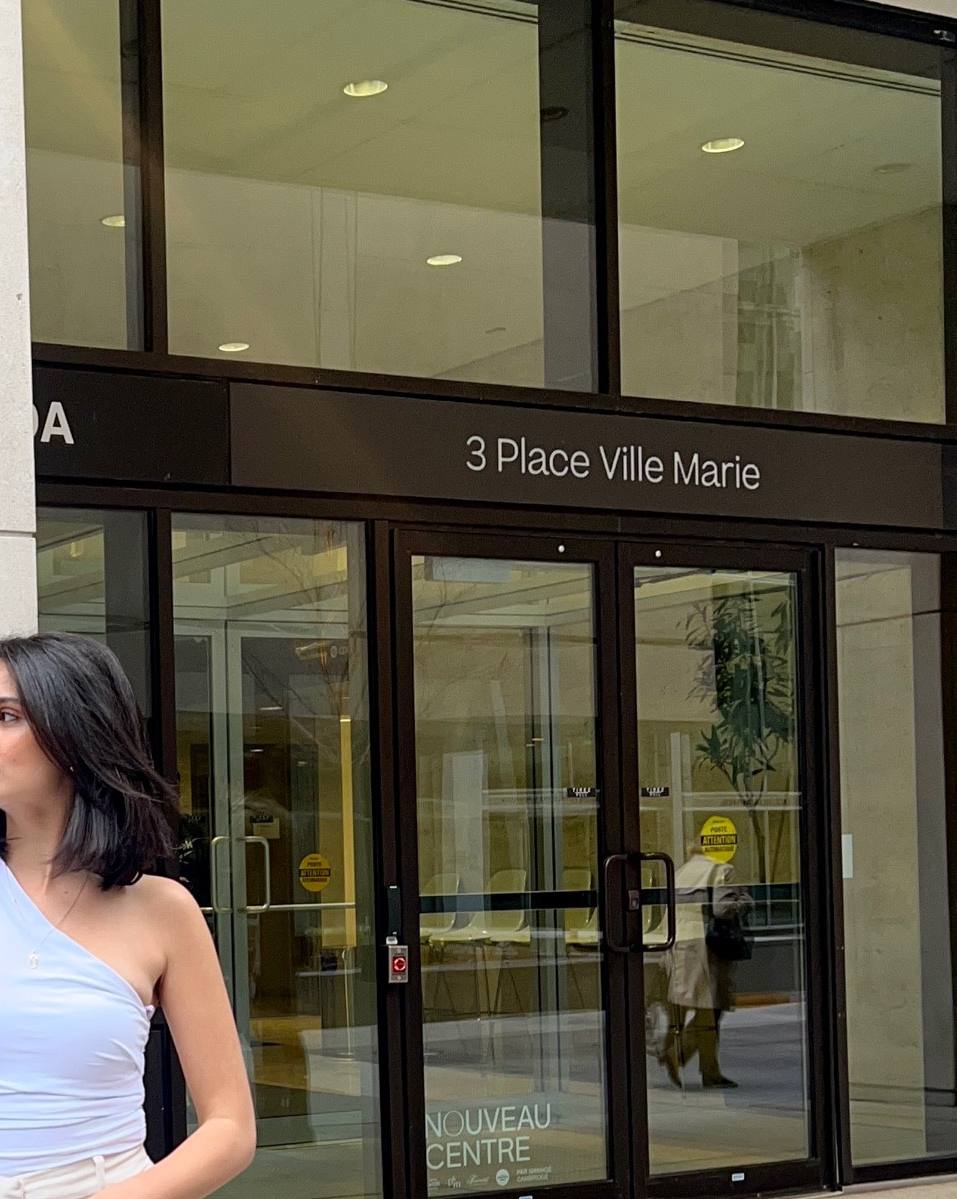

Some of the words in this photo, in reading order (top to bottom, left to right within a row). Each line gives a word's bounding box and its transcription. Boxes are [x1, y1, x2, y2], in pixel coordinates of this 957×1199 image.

[32, 401, 75, 445] A
[466, 435, 487, 471] 3
[497, 437, 590, 478] Place
[599, 446, 664, 483] Ville
[673, 452, 760, 490] Marie
[702, 835, 736, 845] ATTENTION
[300, 869, 330, 877] ATTENTION
[425, 1103, 551, 1138] NOUVEAU
[426, 1136, 531, 1170] CENTRE
